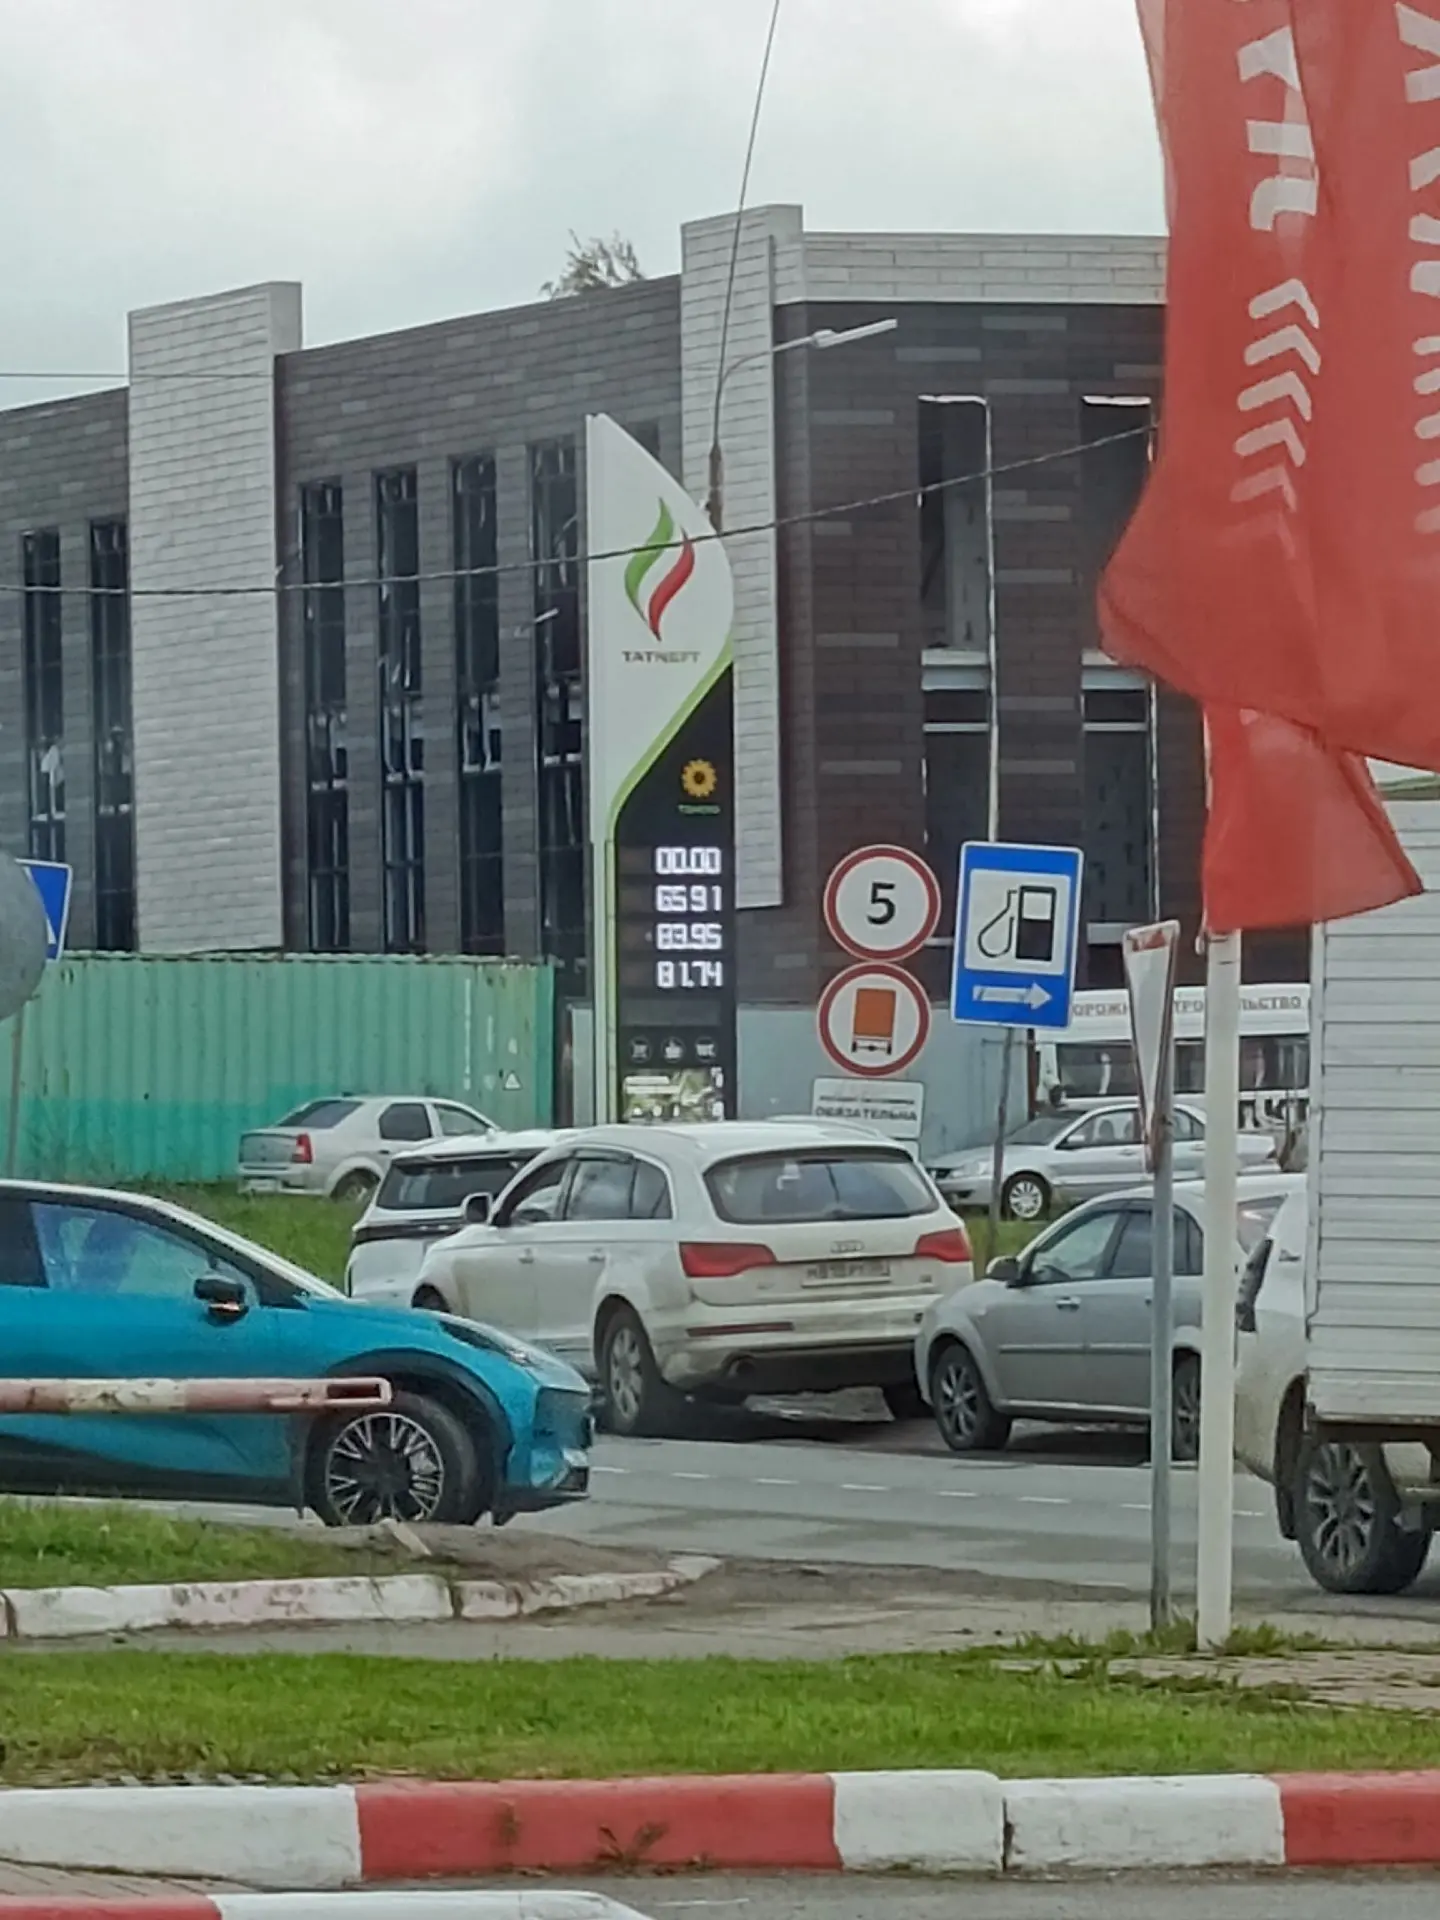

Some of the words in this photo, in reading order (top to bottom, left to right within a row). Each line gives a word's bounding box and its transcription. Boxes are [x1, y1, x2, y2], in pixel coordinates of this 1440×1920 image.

[621, 650, 701, 663] TATNEFT
[867, 882, 896, 925] 5
[656, 961, 723, 988] 81.74
